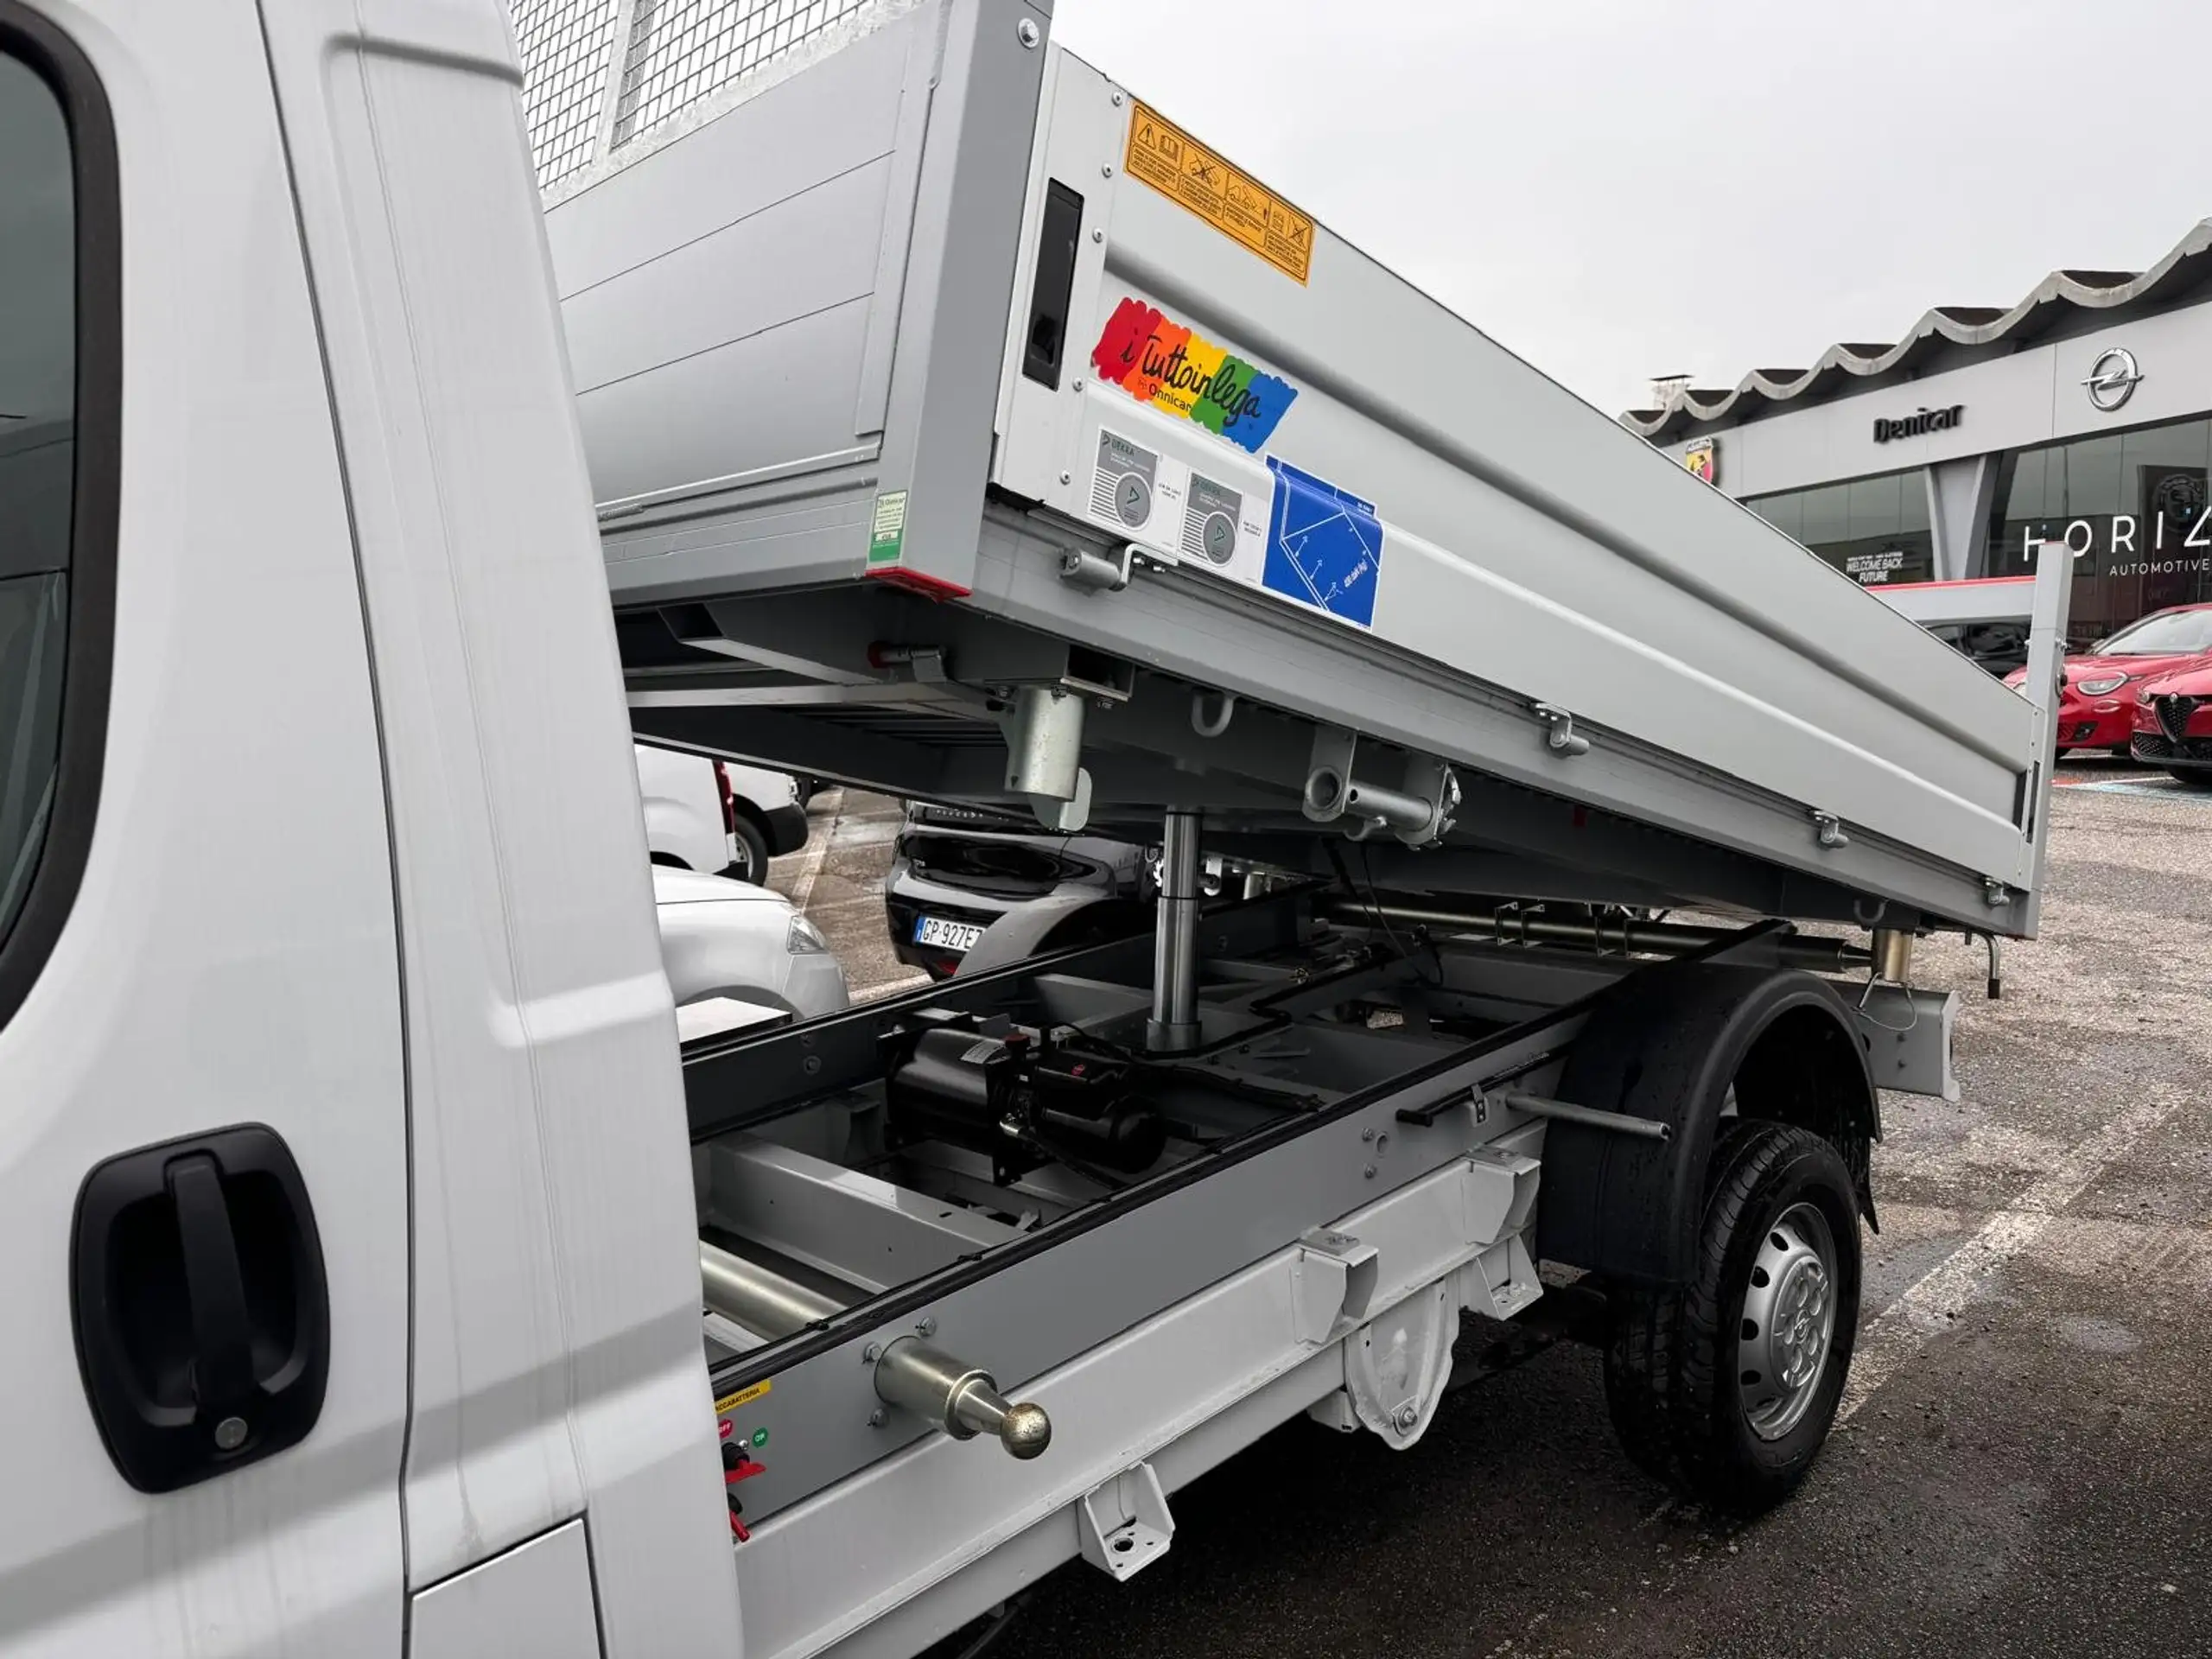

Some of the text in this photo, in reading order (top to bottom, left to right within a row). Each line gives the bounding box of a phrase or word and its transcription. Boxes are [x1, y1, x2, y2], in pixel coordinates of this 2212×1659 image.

[1141, 334, 1262, 427] Tuttoinlega
[1873, 404, 1967, 444] Denicar
[1847, 557, 1904, 573] WELCOME BACK
[2109, 558, 2210, 576] AUTOMOTIVE
[1859, 570, 1888, 583] FUTURE
